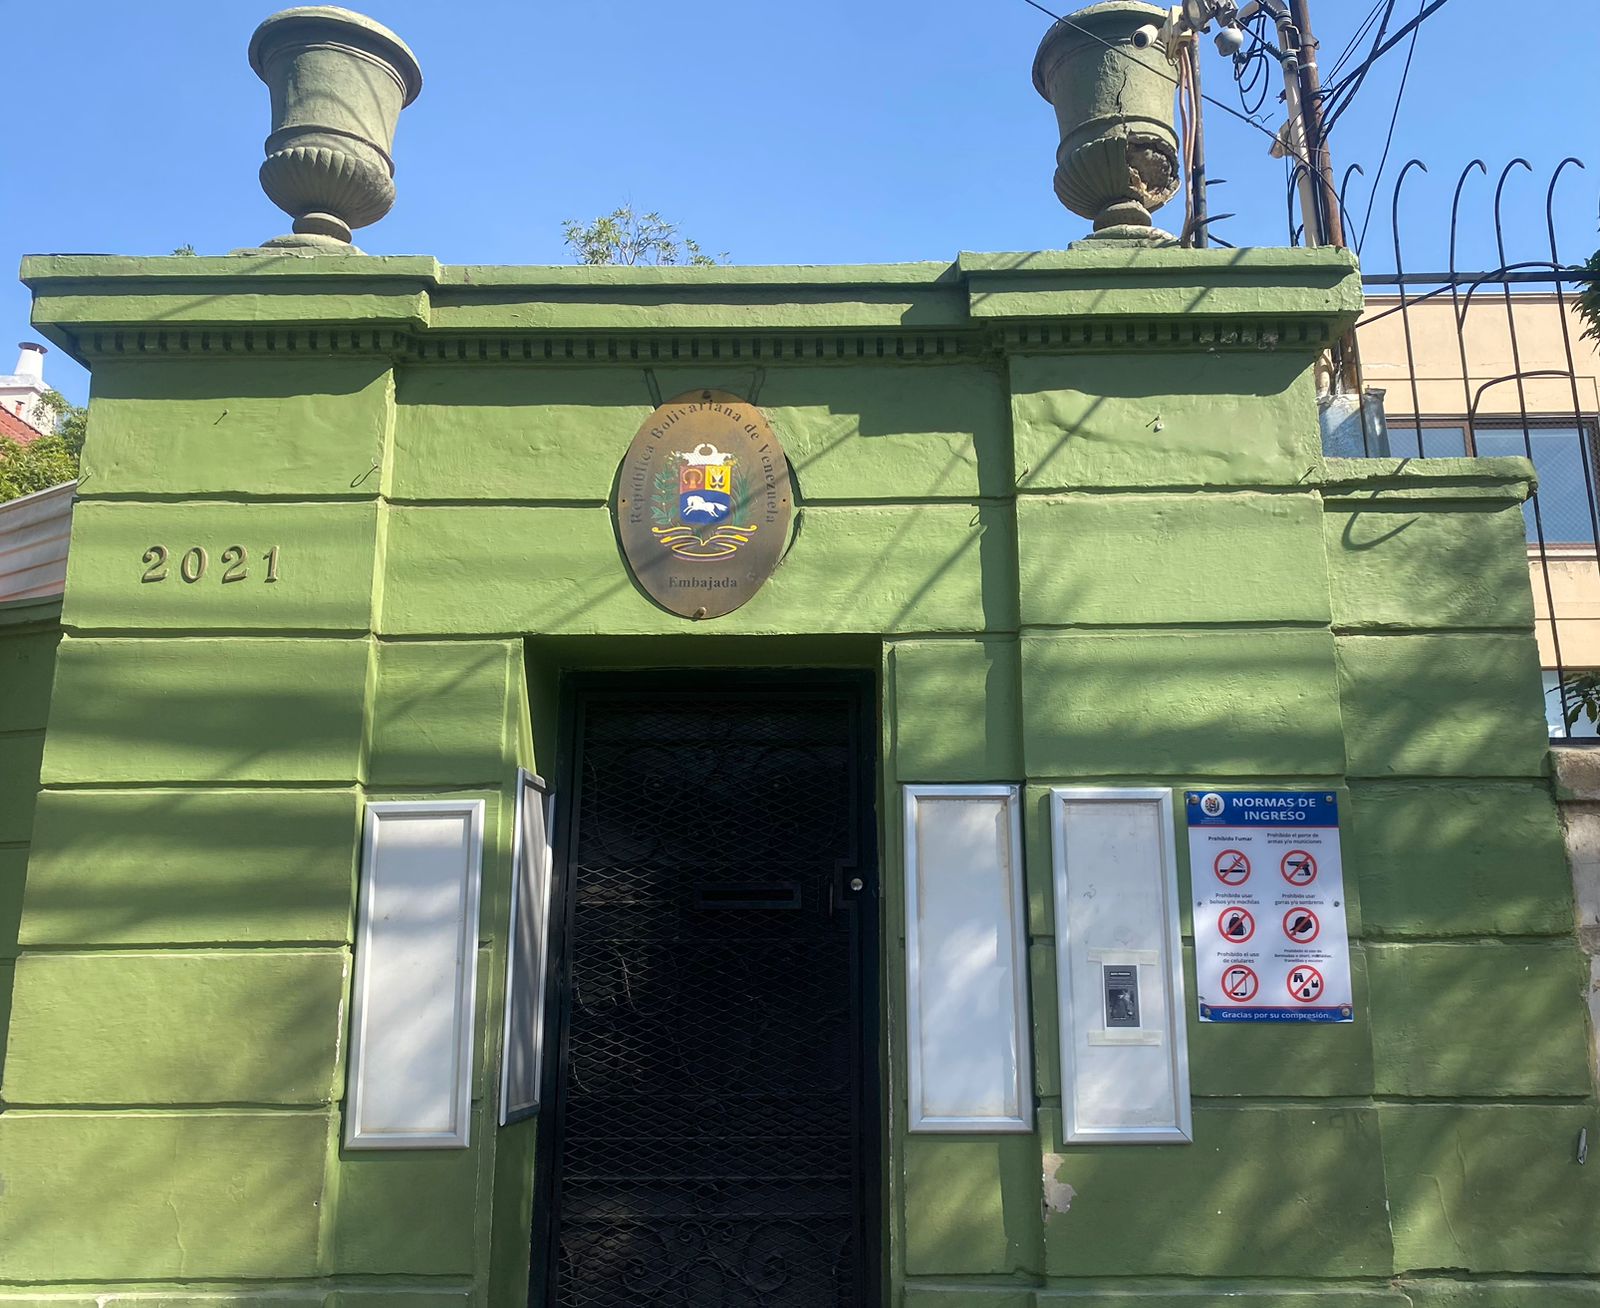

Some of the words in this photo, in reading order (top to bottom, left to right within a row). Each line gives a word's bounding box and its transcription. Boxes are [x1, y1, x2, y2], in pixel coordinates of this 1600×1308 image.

[629, 445, 655, 525] República
[650, 399, 743, 440] Bolivariana
[743, 423, 761, 441] de
[757, 444, 778, 525] Venezuela
[140, 544, 280, 584] 2021
[668, 576, 738, 592] Embajada
[1232, 798, 1295, 808] NORMAS
[1298, 798, 1317, 808] DE
[1244, 811, 1306, 821] INGRESO
[1222, 1010, 1252, 1019] Gracias
[1253, 1012, 1268, 1021] por
